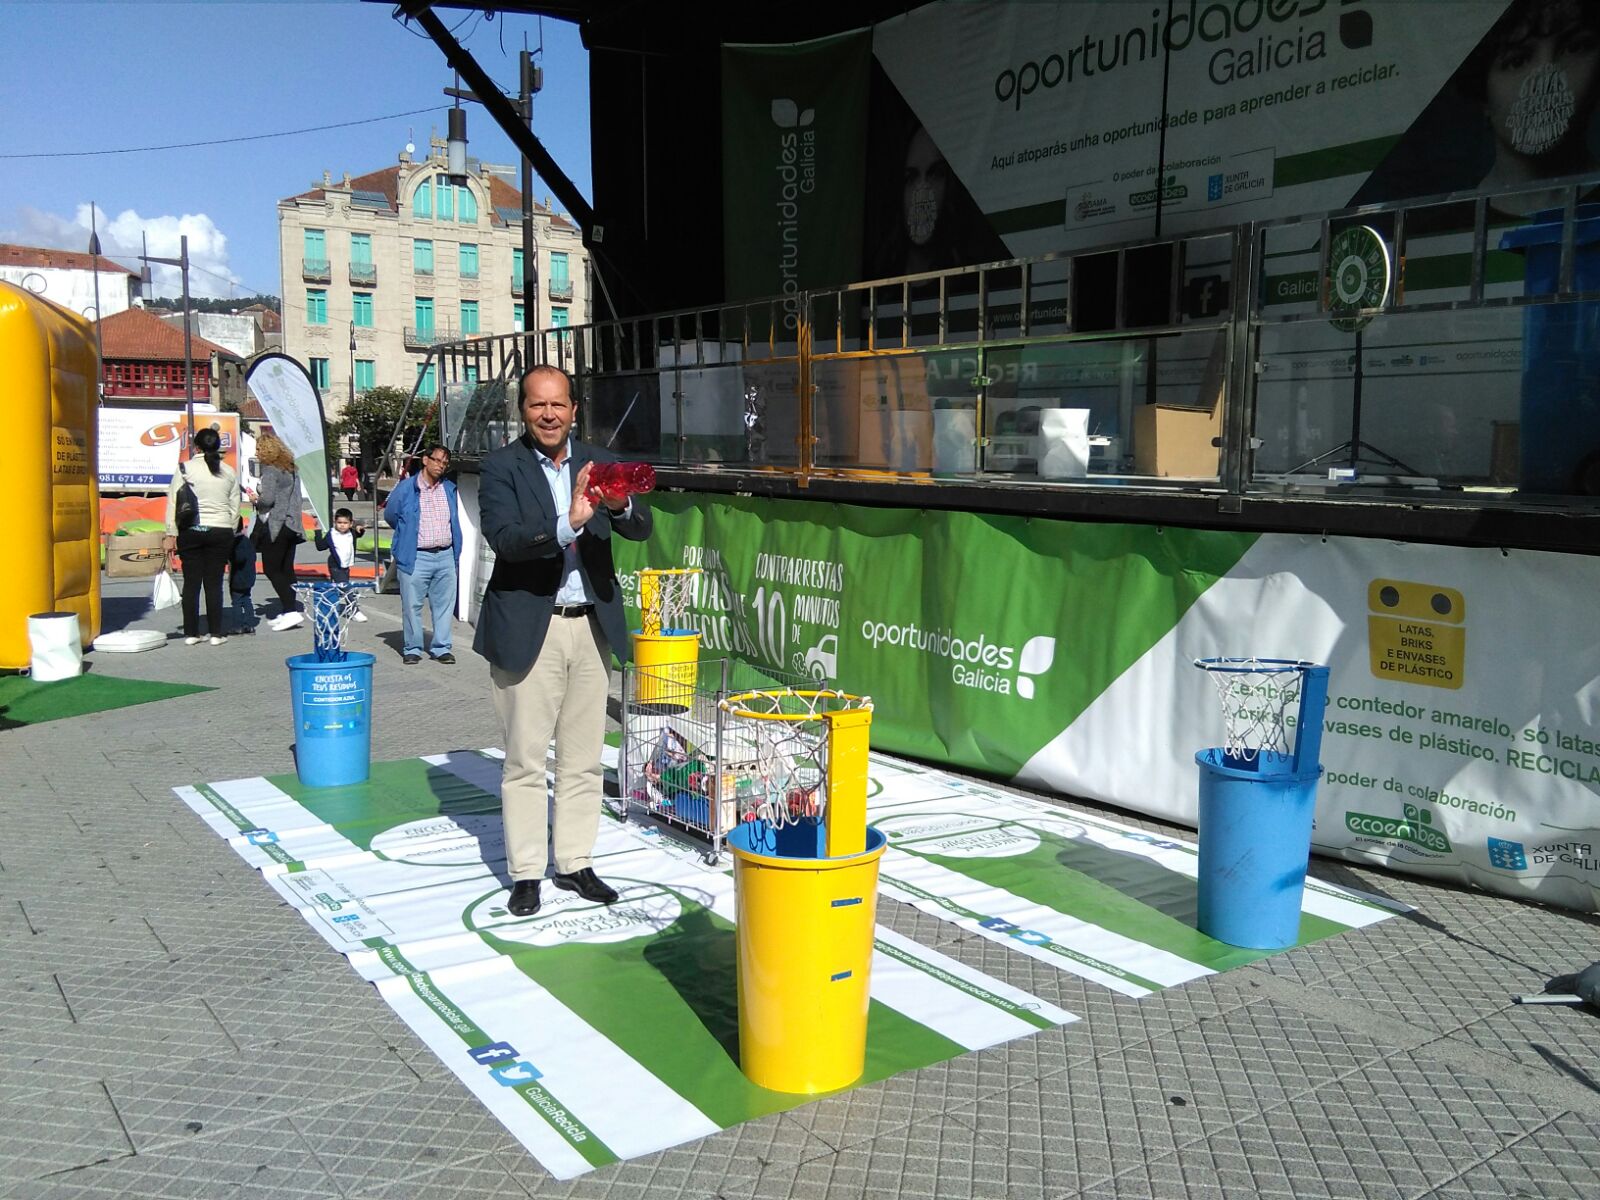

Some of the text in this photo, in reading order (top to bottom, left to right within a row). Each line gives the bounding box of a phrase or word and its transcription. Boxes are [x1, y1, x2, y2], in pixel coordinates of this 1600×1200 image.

[1208, 27, 1327, 85] Galicia
[1017, 140, 1067, 164] atoparás
[1070, 133, 1099, 152] unha
[1102, 109, 1198, 148] oportunidade
[1203, 103, 1236, 125] para
[1240, 83, 1312, 115] aprender
[1315, 82, 1326, 94] a
[1331, 62, 1400, 92] reciclar.
[800, 130, 816, 194] Galicia
[1120, 169, 1144, 182] poder
[775, 132, 799, 331] oportunidades
[99, 474, 154, 483] 981 671 475
[682, 545, 703, 568] POR
[755, 552, 844, 592] CONTRARRESTAS
[751, 586, 786, 669] 10
[793, 594, 840, 629] MINUTOS
[791, 623, 802, 645] DE
[861, 620, 1015, 669] oportunidades
[1401, 637, 1433, 651] BRIKS
[1380, 660, 1453, 680] DE PLÁSTICO
[1387, 648, 1447, 666] E ENVASES
[952, 665, 1011, 695] Galicia
[1336, 695, 1426, 721] contedor
[1431, 708, 1516, 742] amarelo,
[1523, 725, 1550, 745] só
[1285, 714, 1297, 728] e
[1325, 719, 1383, 740] vases
[1388, 725, 1414, 745] de
[1419, 732, 1499, 764] plástico.
[1506, 749, 1600, 785] RECICLA
[1327, 771, 1517, 823] poder da colaboración
[1349, 816, 1448, 850] ecoembes
[1532, 843, 1592, 855] XUNTA
[1533, 853, 1600, 874] DE GALI
[1050, 943, 1126, 977] GaliciaRecicla
[525, 1086, 586, 1143] GaliciaRecicla
